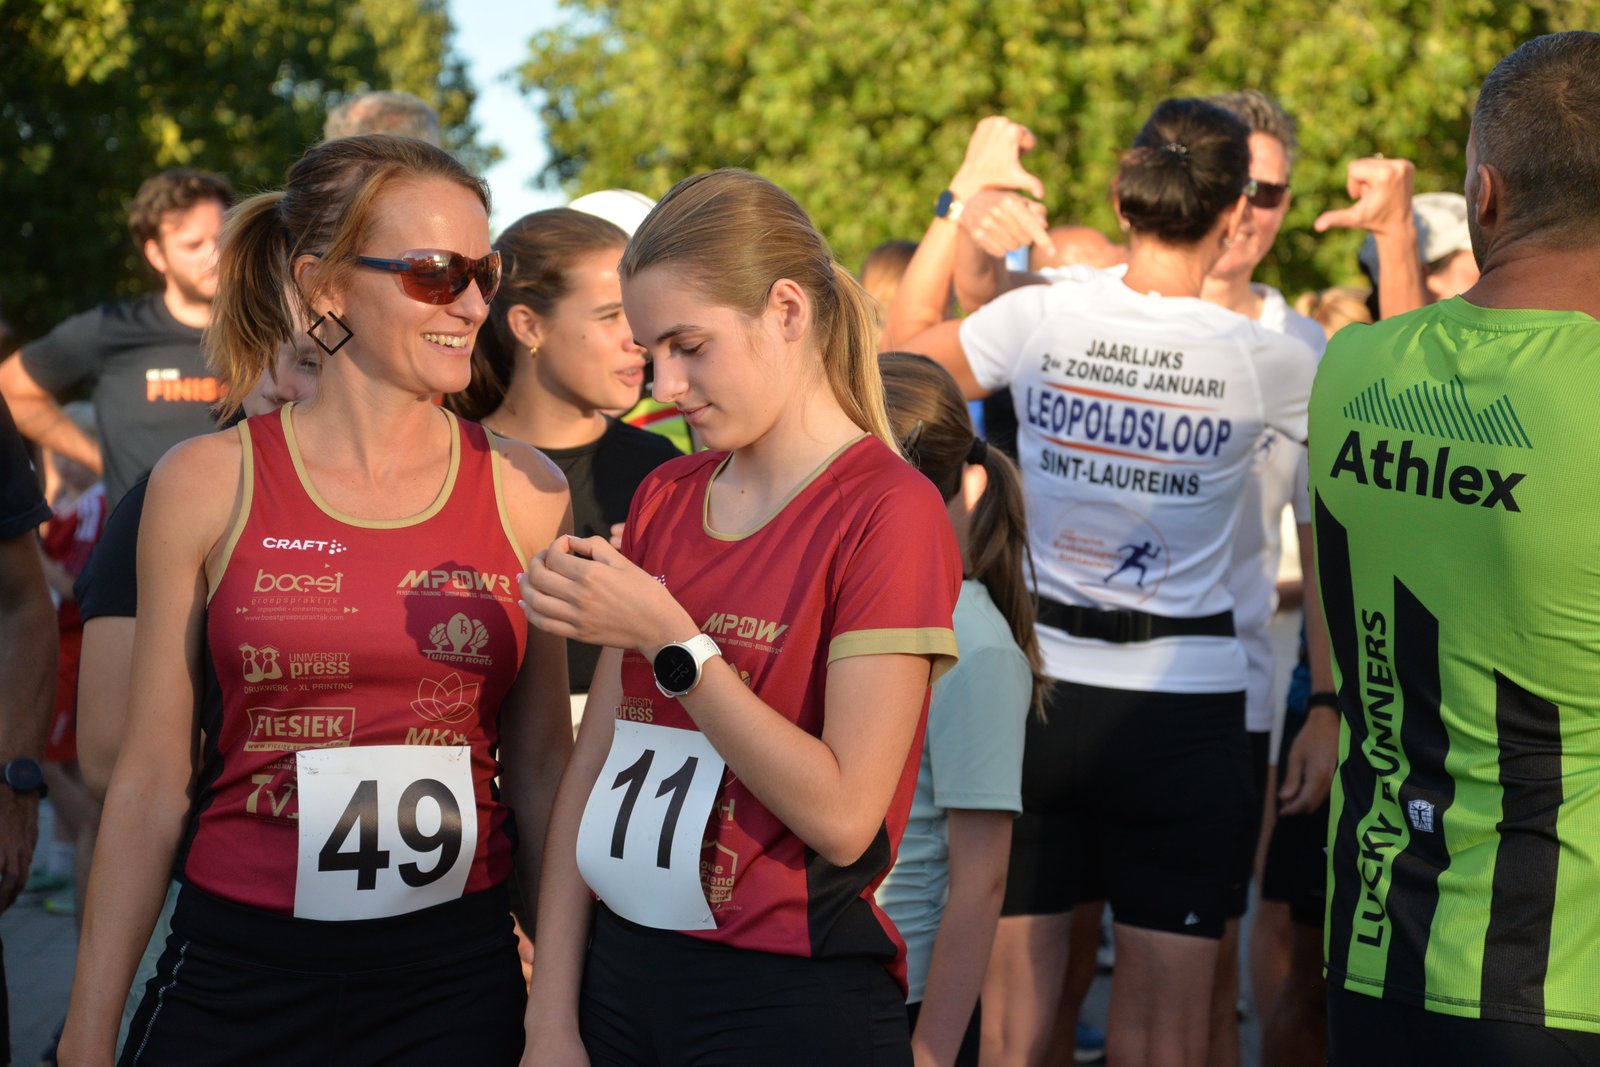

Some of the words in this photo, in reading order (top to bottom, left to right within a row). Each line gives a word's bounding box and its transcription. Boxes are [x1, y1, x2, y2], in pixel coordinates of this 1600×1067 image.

[1086, 340, 1183, 370] JAARLIJKS
[146, 377, 228, 402] FINIS
[1065, 359, 1138, 388] ZONDAG
[1143, 373, 1226, 399] JANUARI
[1027, 386, 1232, 457] LEOPOLDSLOOP
[1040, 450, 1200, 496] SINT-LAUREINS
[1329, 430, 1527, 513] Athlex
[262, 537, 328, 552] CRAFT
[288, 652, 351, 662] UNIVERSITY
[289, 661, 350, 680] press
[299, 683, 310, 692] XL
[312, 682, 353, 690] PRINTING
[253, 714, 345, 738] FIESIEK
[610, 748, 699, 870] 11
[317, 777, 463, 891] 49
[1356, 811, 1403, 948] LUCKY
